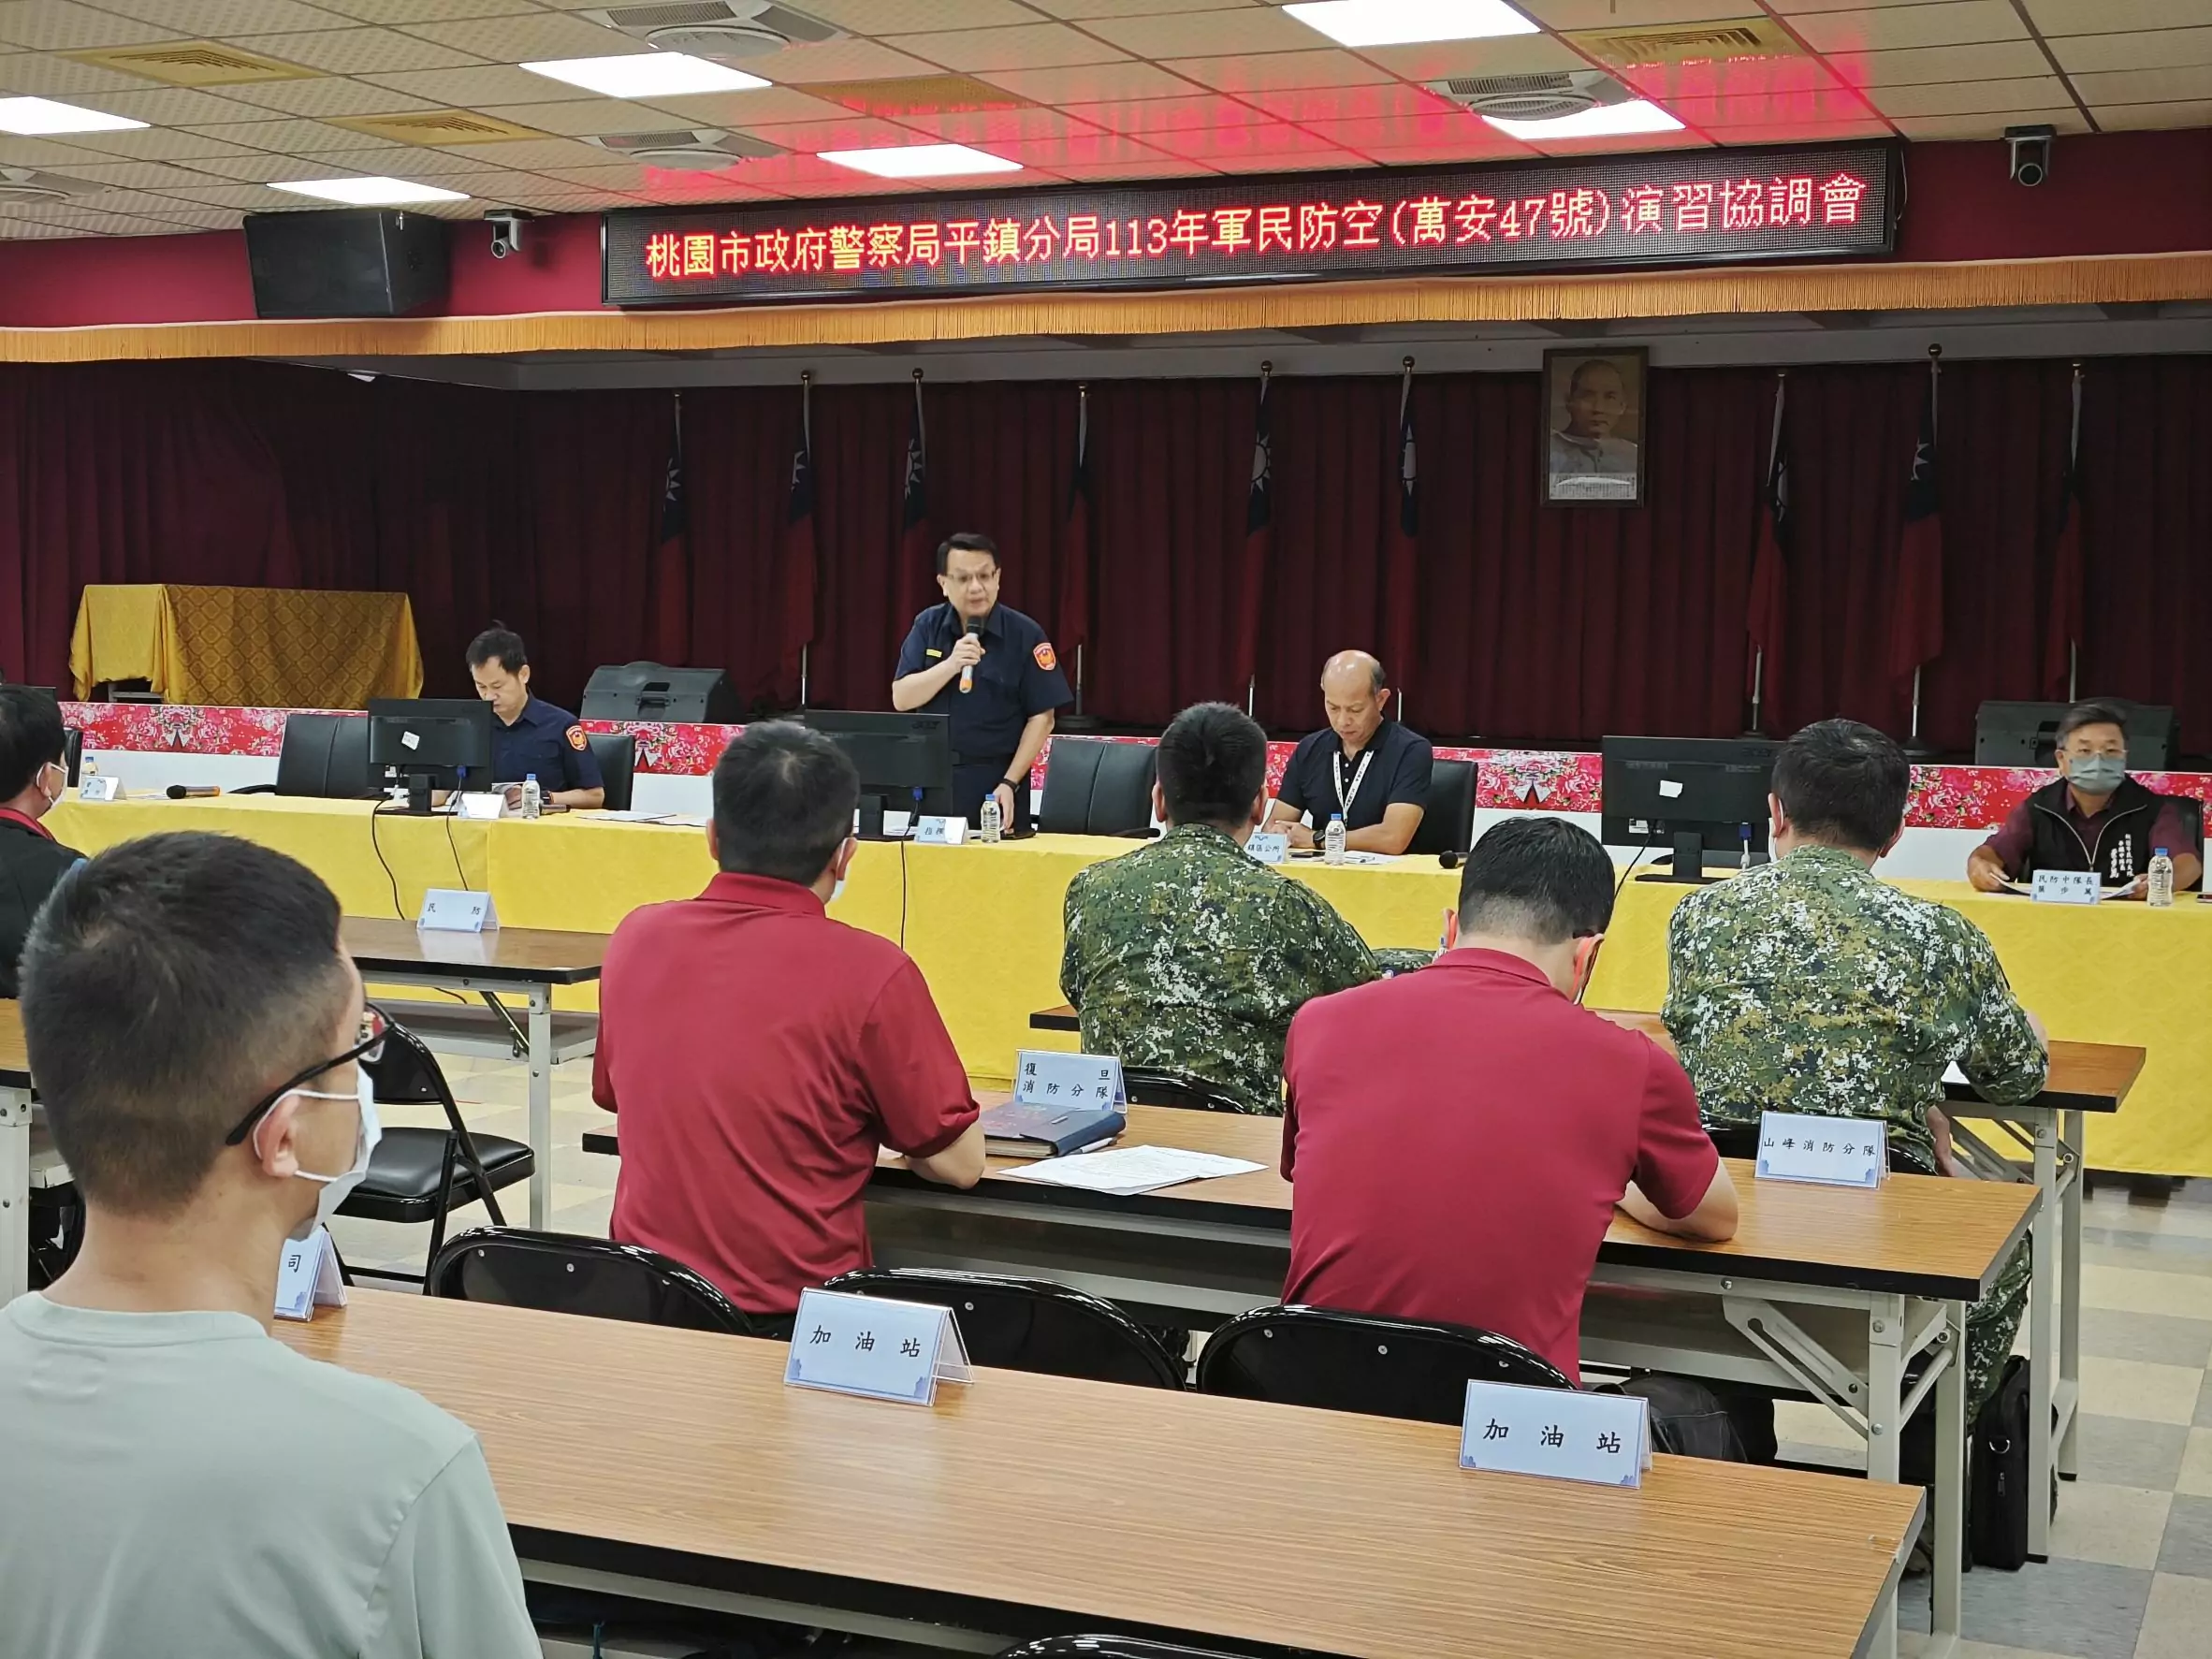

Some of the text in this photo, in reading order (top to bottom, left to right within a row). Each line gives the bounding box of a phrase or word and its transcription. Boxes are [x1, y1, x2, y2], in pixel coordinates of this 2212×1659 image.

[2038, 875, 2093, 885] 民防中隊長
[1024, 1062, 1111, 1081] 復旦
[1023, 1080, 1109, 1099] 消防分隊
[1763, 1137, 1876, 1157] 山峰消防分隊
[809, 1324, 921, 1358] 加油站
[1482, 1418, 1622, 1454] 加油站
